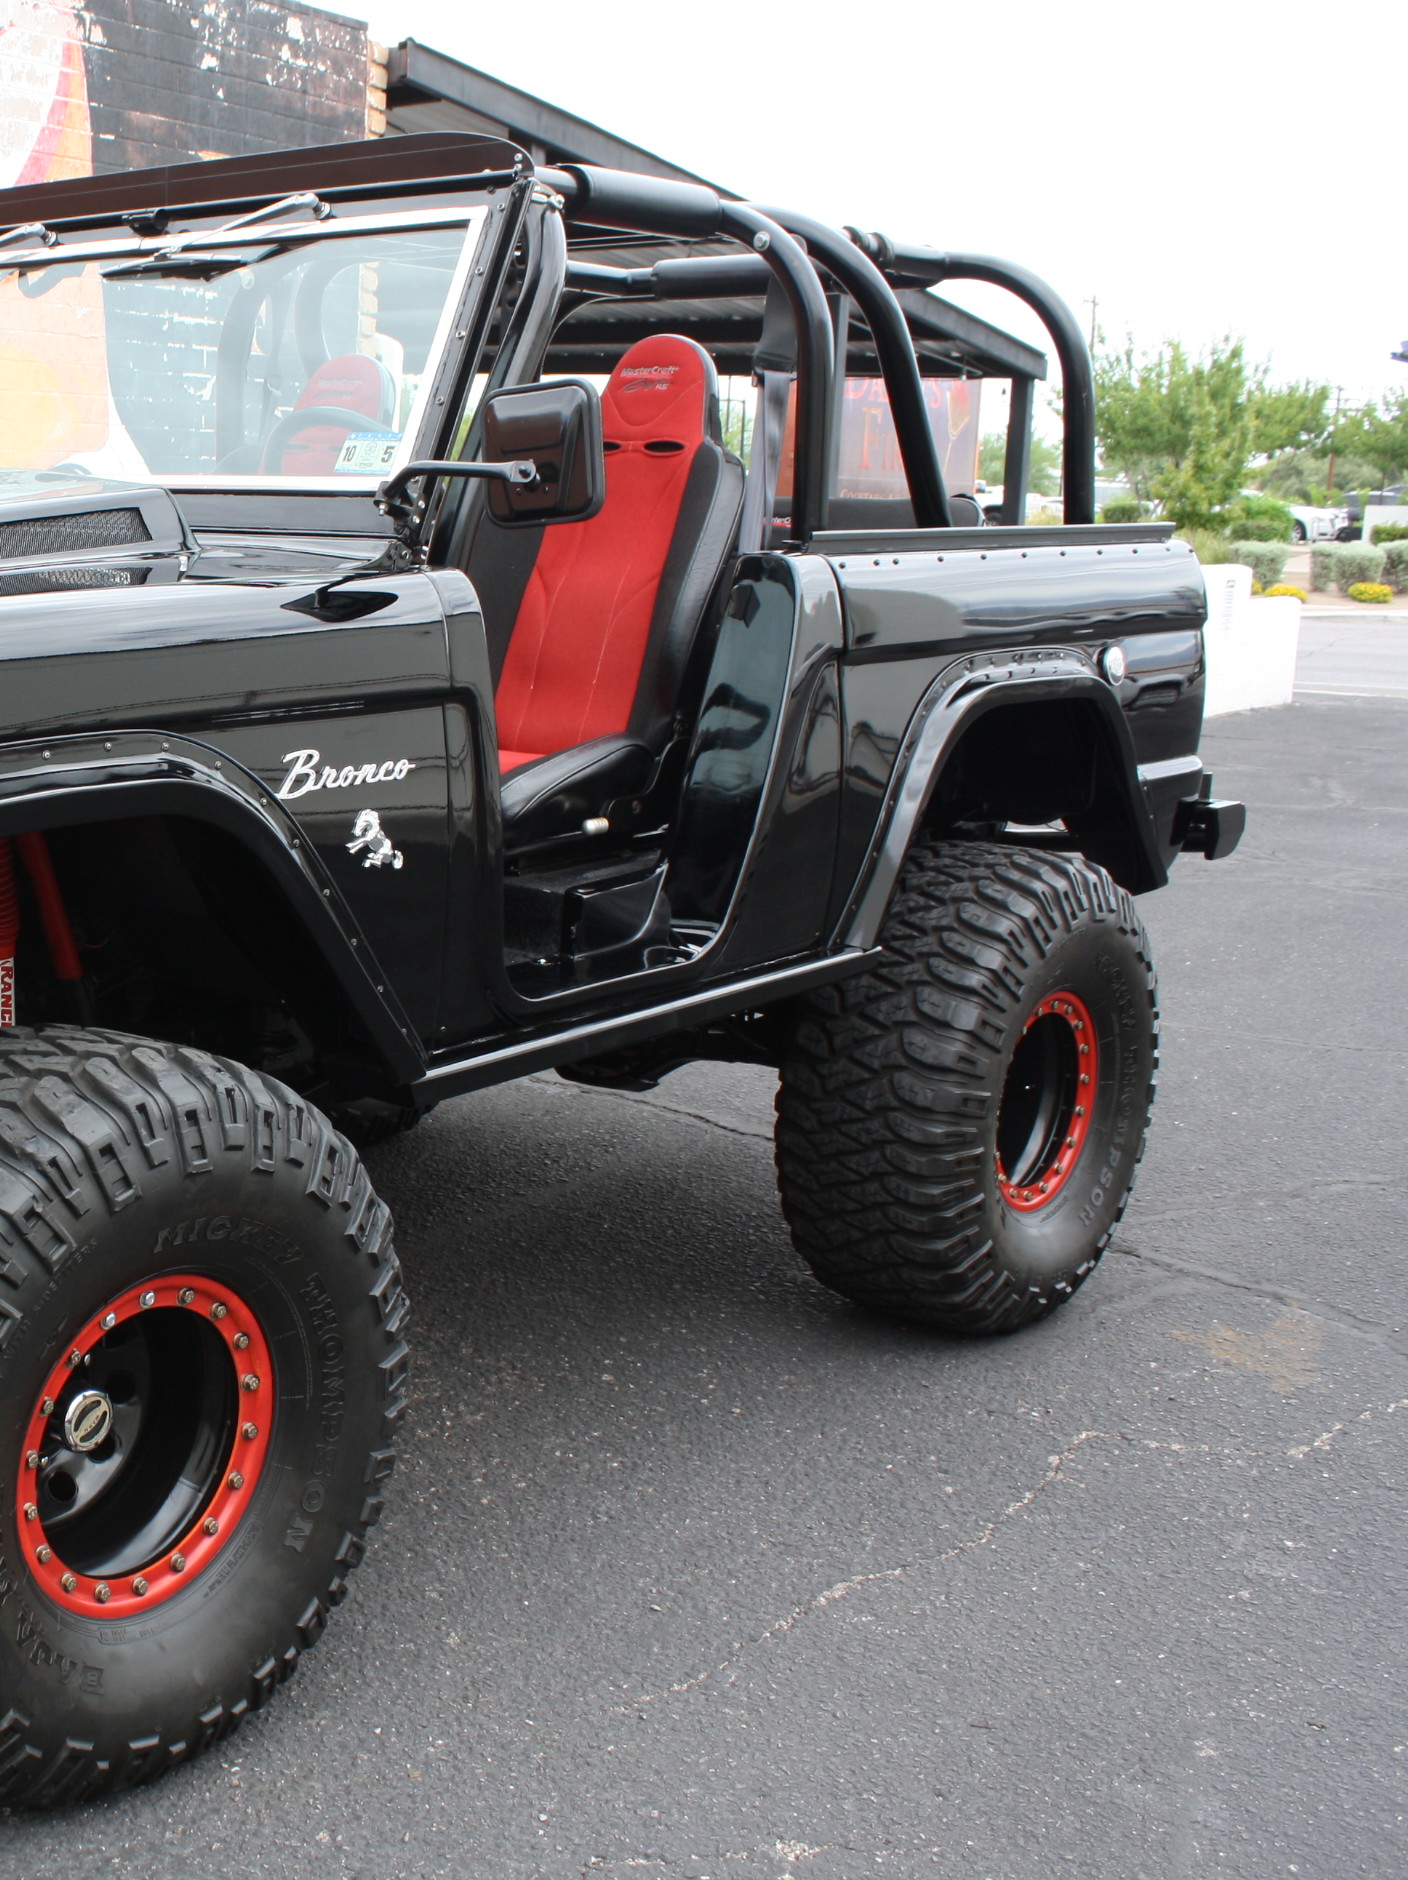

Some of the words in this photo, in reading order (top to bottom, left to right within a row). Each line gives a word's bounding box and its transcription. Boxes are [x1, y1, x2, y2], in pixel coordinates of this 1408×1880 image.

[343, 445, 357, 462] 10
[382, 445, 396, 463] 5
[274, 749, 416, 800] Bronco
[153, 1215, 305, 1265] MICKEY
[283, 1271, 345, 1552] THOMPSON
[16, 1608, 105, 1696] BAJA
